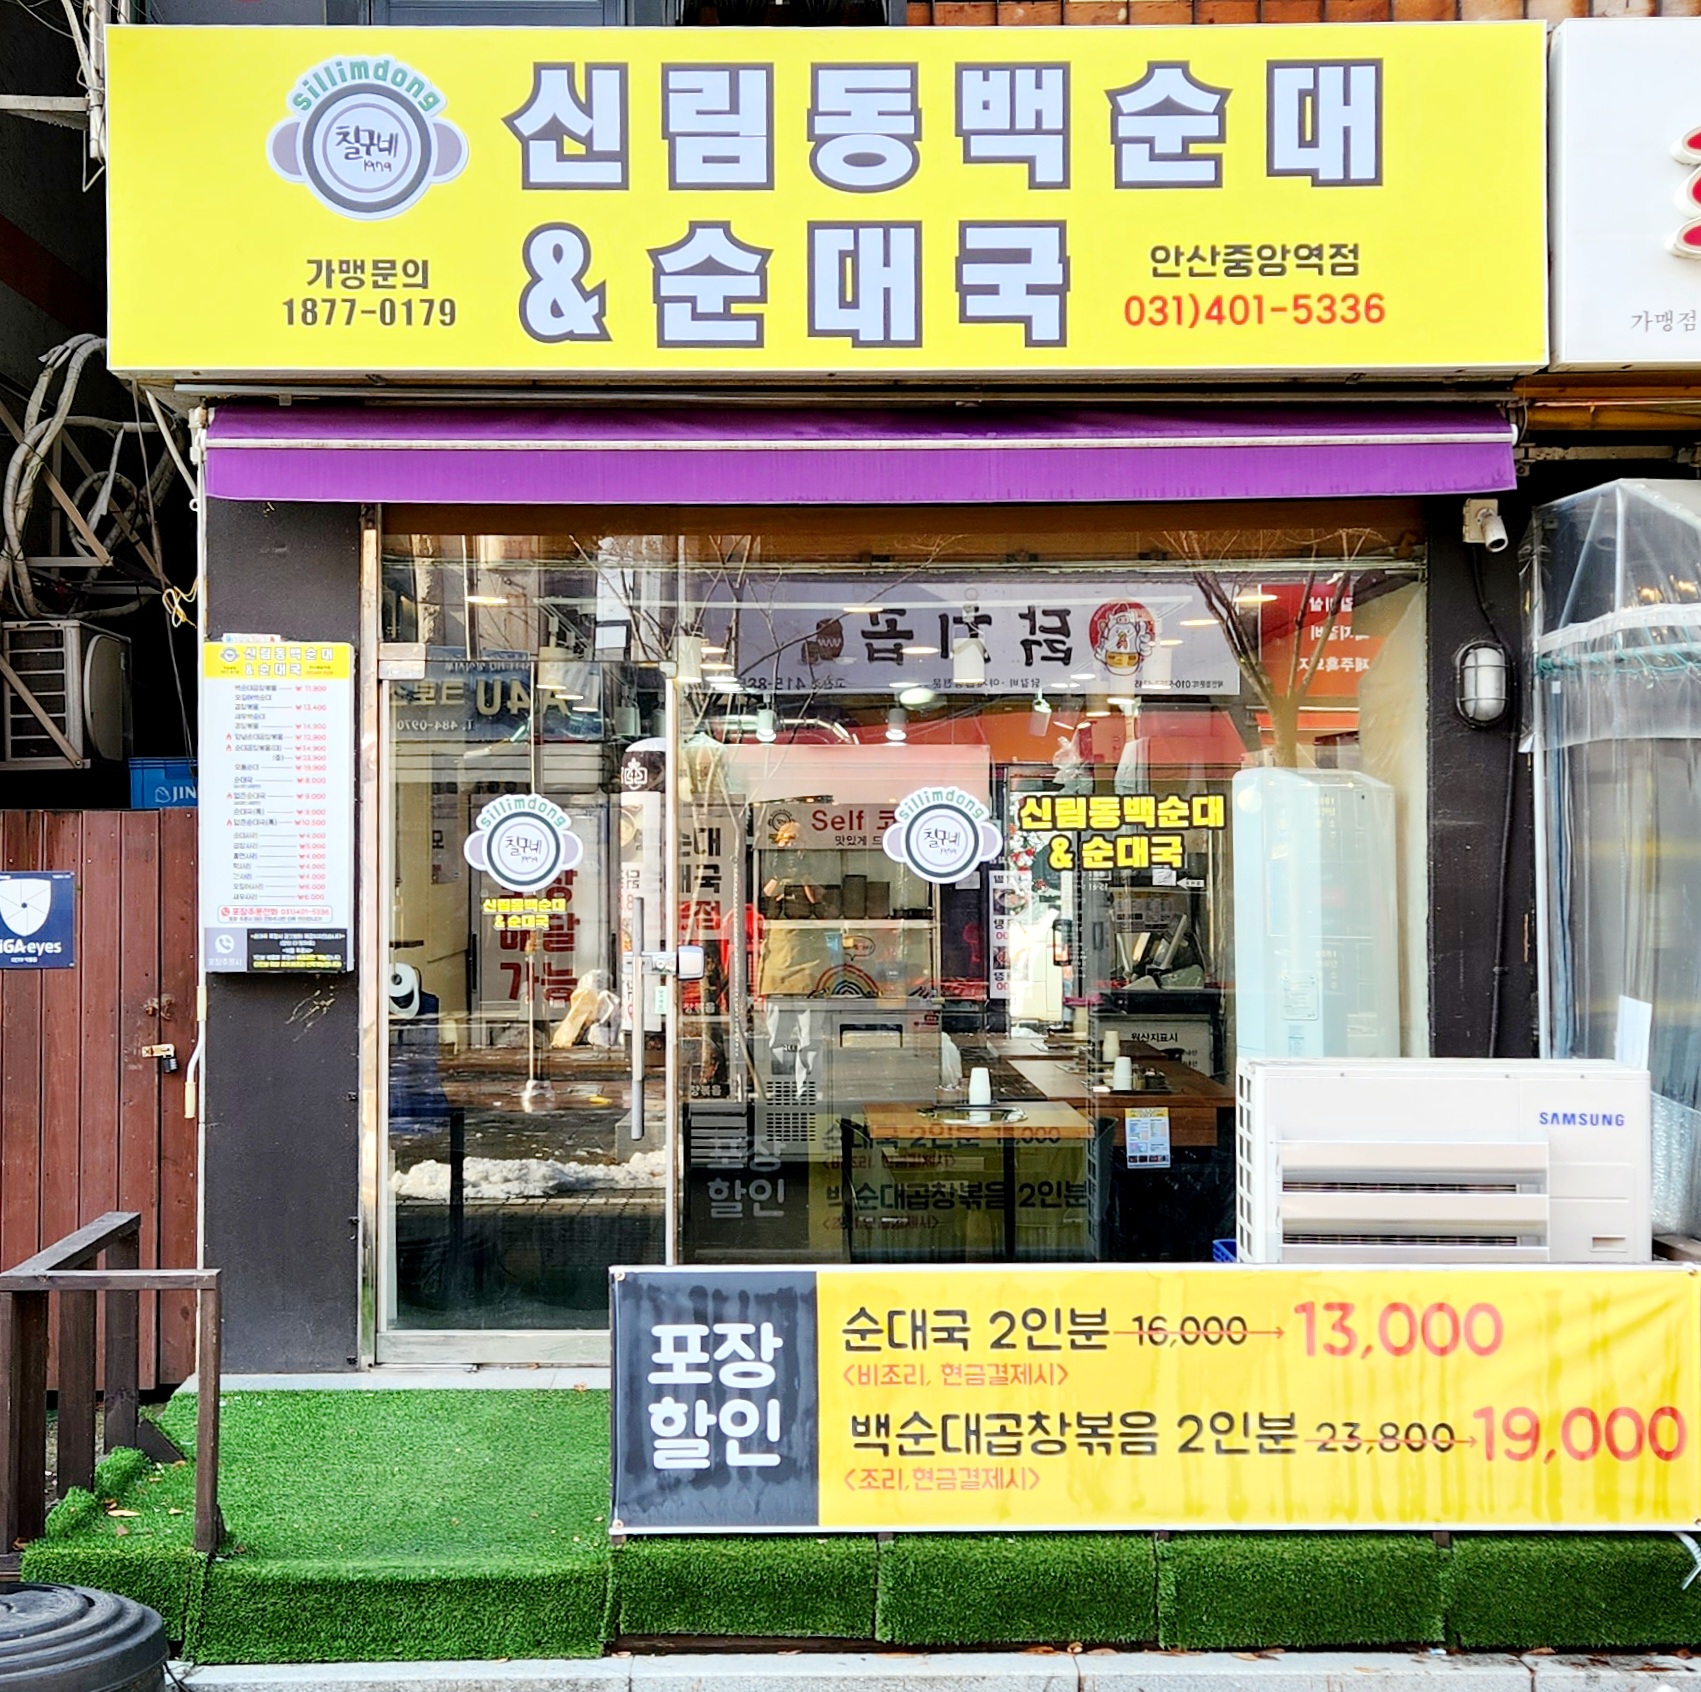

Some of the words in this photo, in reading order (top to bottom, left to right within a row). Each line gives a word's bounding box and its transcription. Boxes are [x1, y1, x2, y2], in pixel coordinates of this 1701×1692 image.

[292, 57, 441, 112] sillimdong
[335, 124, 398, 161] 칠구네
[500, 57, 1383, 192] 신림동백순대
[306, 258, 429, 289] 가맹문의
[1149, 243, 1361, 278] 안산중앙역점
[519, 221, 612, 345] &
[646, 219, 1070, 348] 순대국
[282, 298, 457, 326] 1877-0179
[1124, 291, 1386, 328] 031)401-5336
[1631, 309, 1697, 333] 가맹점
[480, 797, 567, 828] sillimdong
[811, 809, 864, 831] Self
[898, 789, 985, 819] sillimdong
[1018, 793, 1227, 831] 신림동백순대
[1048, 834, 1075, 872] &
[1081, 833, 1186, 870] 순대국
[1539, 1111, 1625, 1127] SAMSUNG
[707, 1178, 785, 1218] 할인
[842, 1306, 971, 1353] 순대국
[989, 1306, 1111, 1352] 2인분
[1131, 1314, 1248, 1348] 16,000
[1294, 1300, 1504, 1360] 13,000
[647, 1321, 784, 1389] 포장
[647, 1396, 782, 1471] 할인
[851, 1409, 1157, 1457] 백순대곱창볶음
[1176, 1410, 1299, 1456] 2인분
[1316, 1421, 1456, 1456] 23,800
[1473, 1404, 1688, 1465] 19,000
